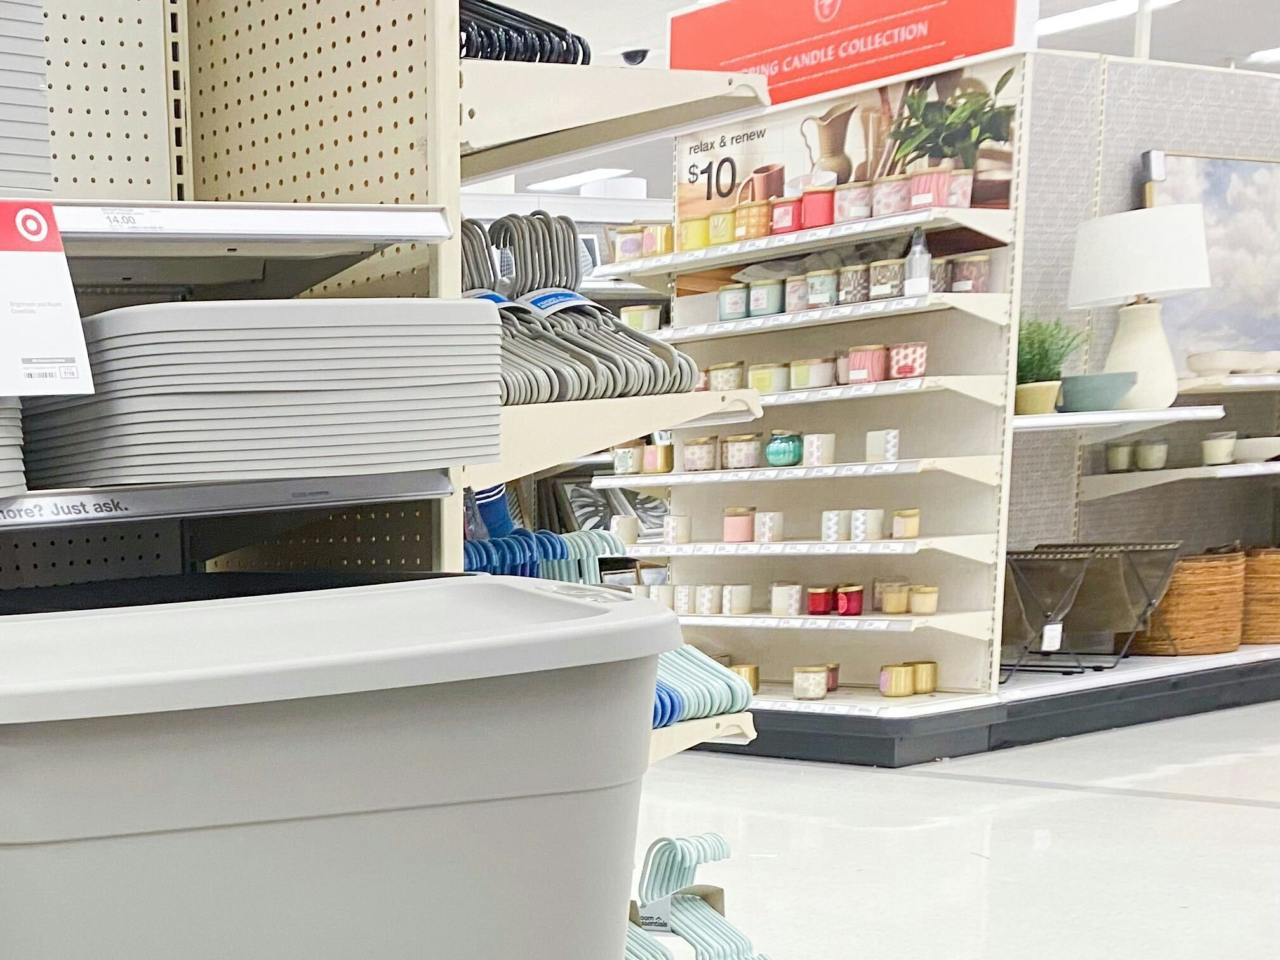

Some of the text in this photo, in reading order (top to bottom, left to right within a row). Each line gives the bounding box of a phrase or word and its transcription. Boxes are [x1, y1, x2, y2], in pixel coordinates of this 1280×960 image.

[783, 45, 835, 72] CANDLE
[838, 22, 928, 58] COLLECTION
[689, 128, 767, 155] relax & renew
[688, 156, 737, 201] $10
[106, 215, 136, 225] 14.00
[51, 501, 90, 517] Just
[93, 498, 129, 514] ask.
